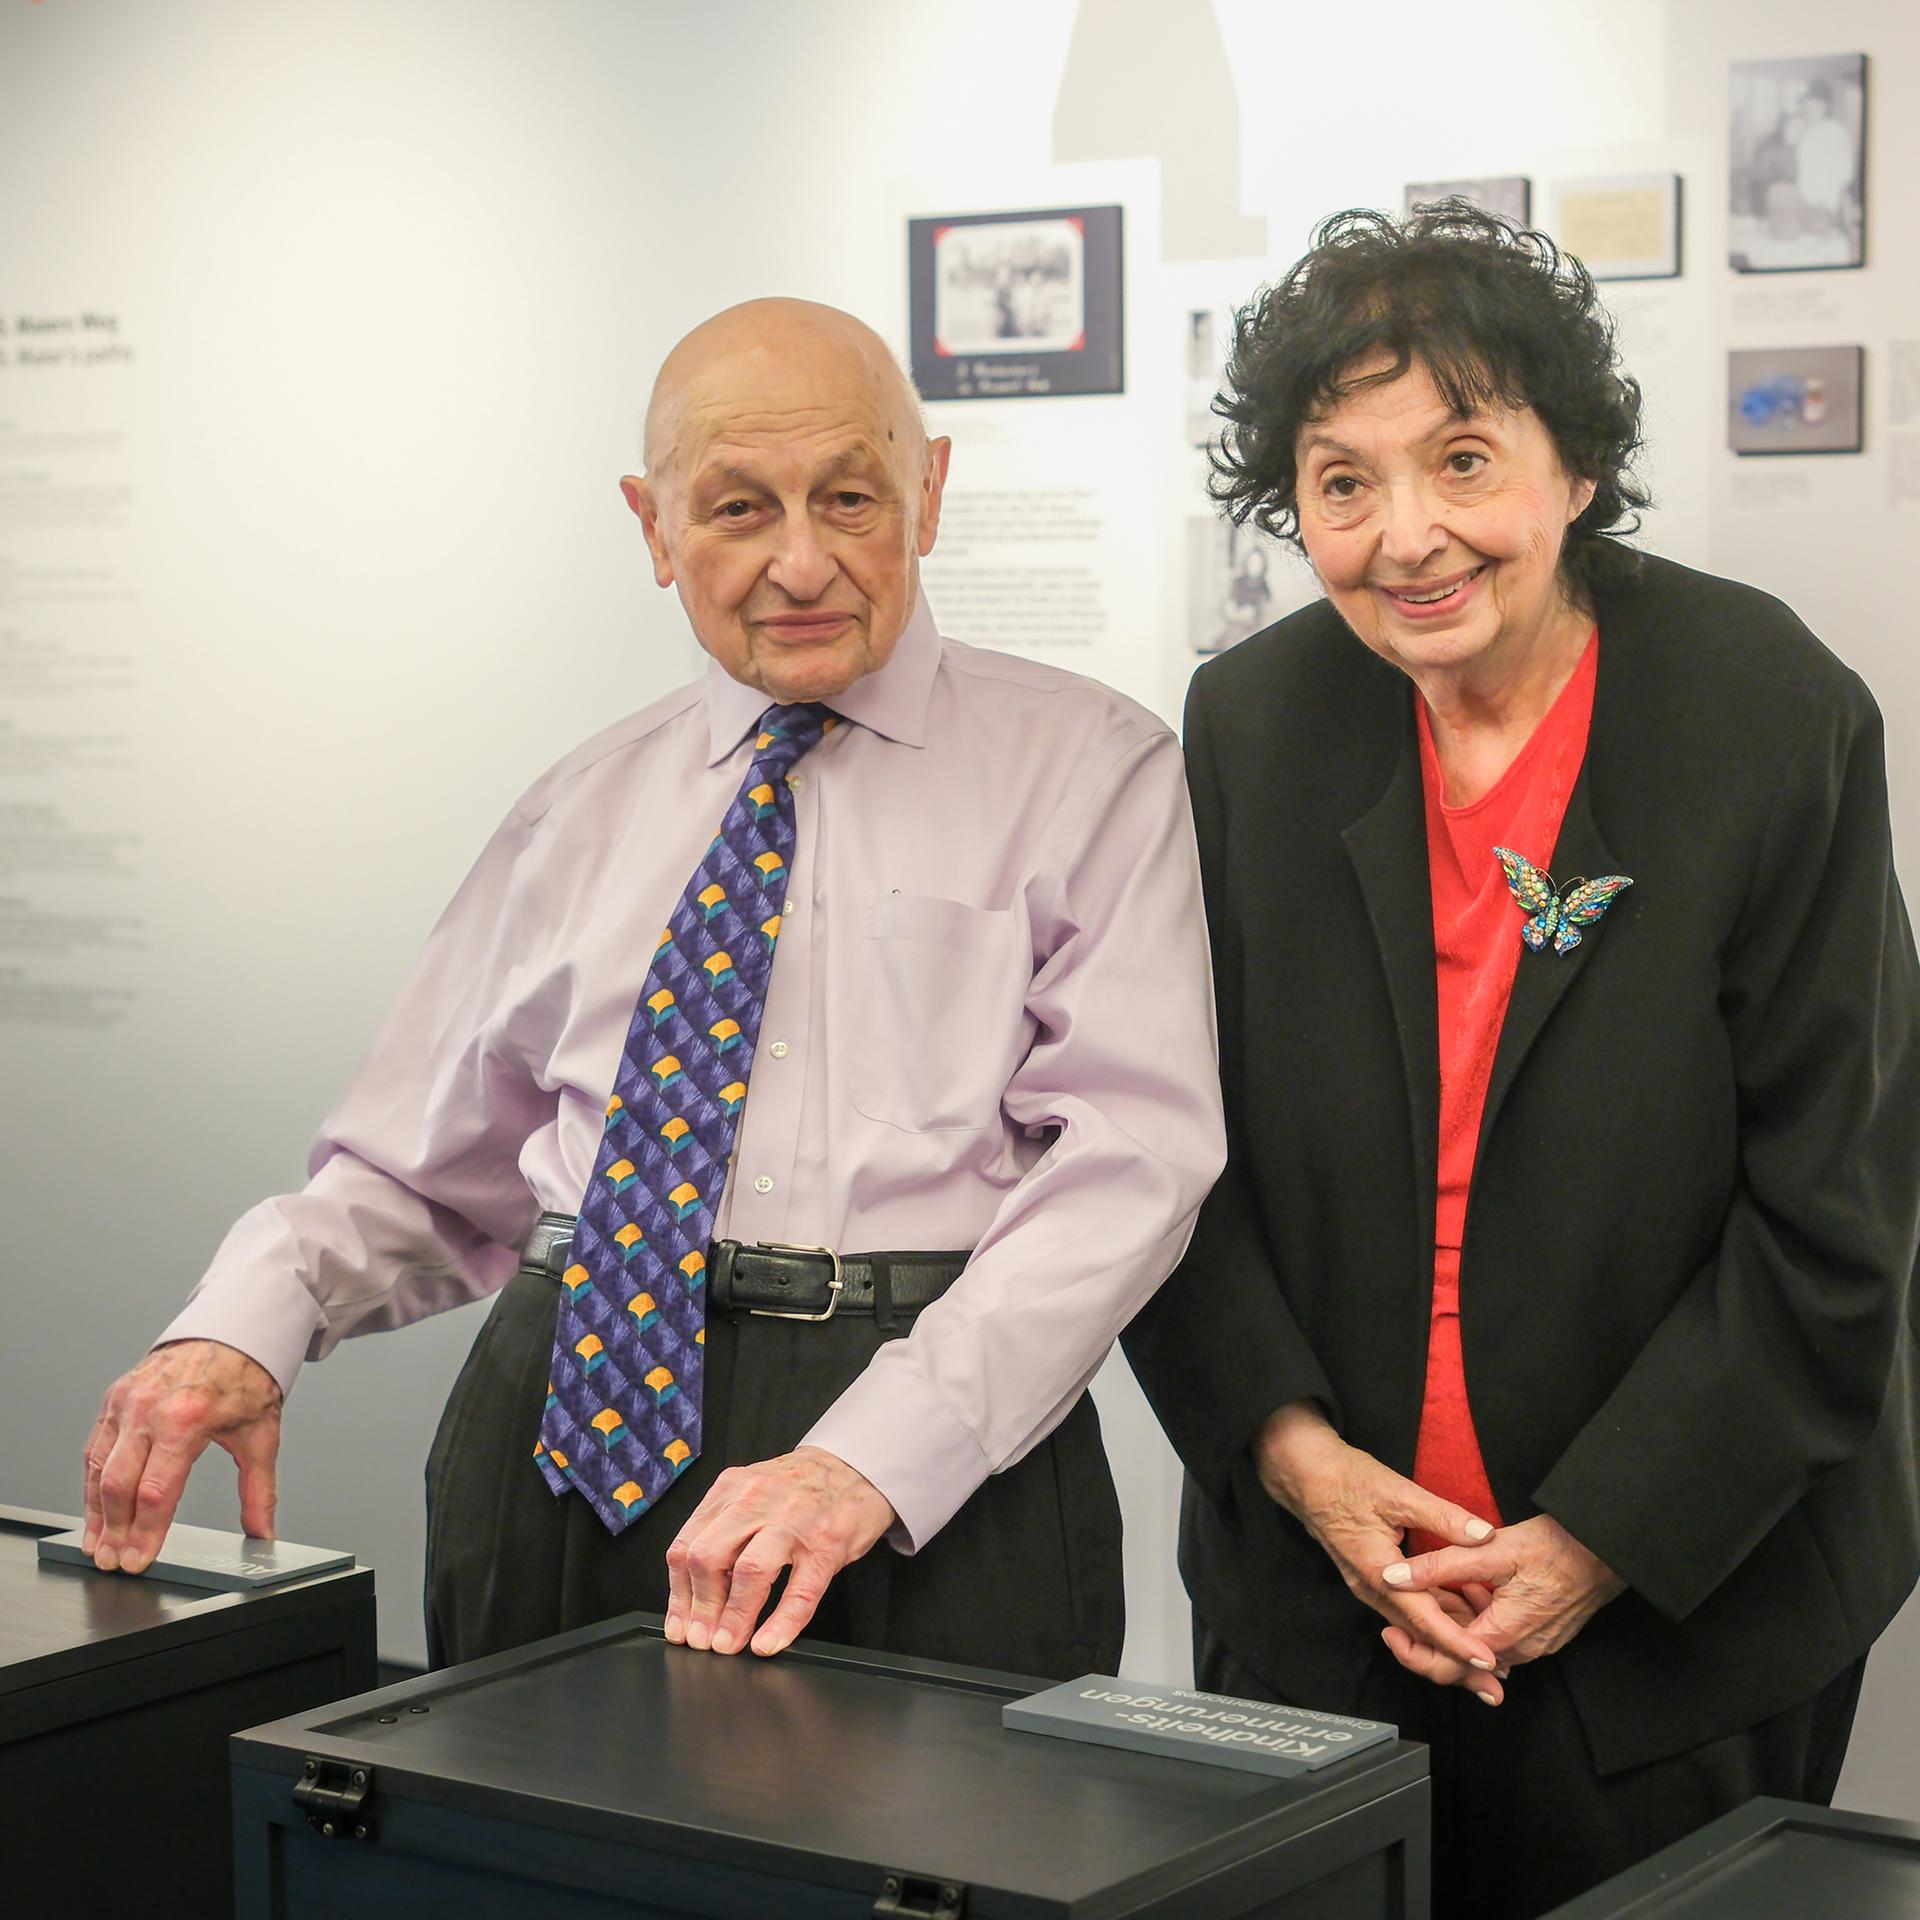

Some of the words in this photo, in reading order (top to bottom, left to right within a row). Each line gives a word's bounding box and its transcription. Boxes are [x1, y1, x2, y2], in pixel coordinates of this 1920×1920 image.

[1079, 1689, 1354, 1742] erinnerungen
[1172, 1689, 1269, 1713] memories
[1115, 1712, 1328, 1757] Kindheits-
[1271, 1707, 1378, 1730] Childhood
